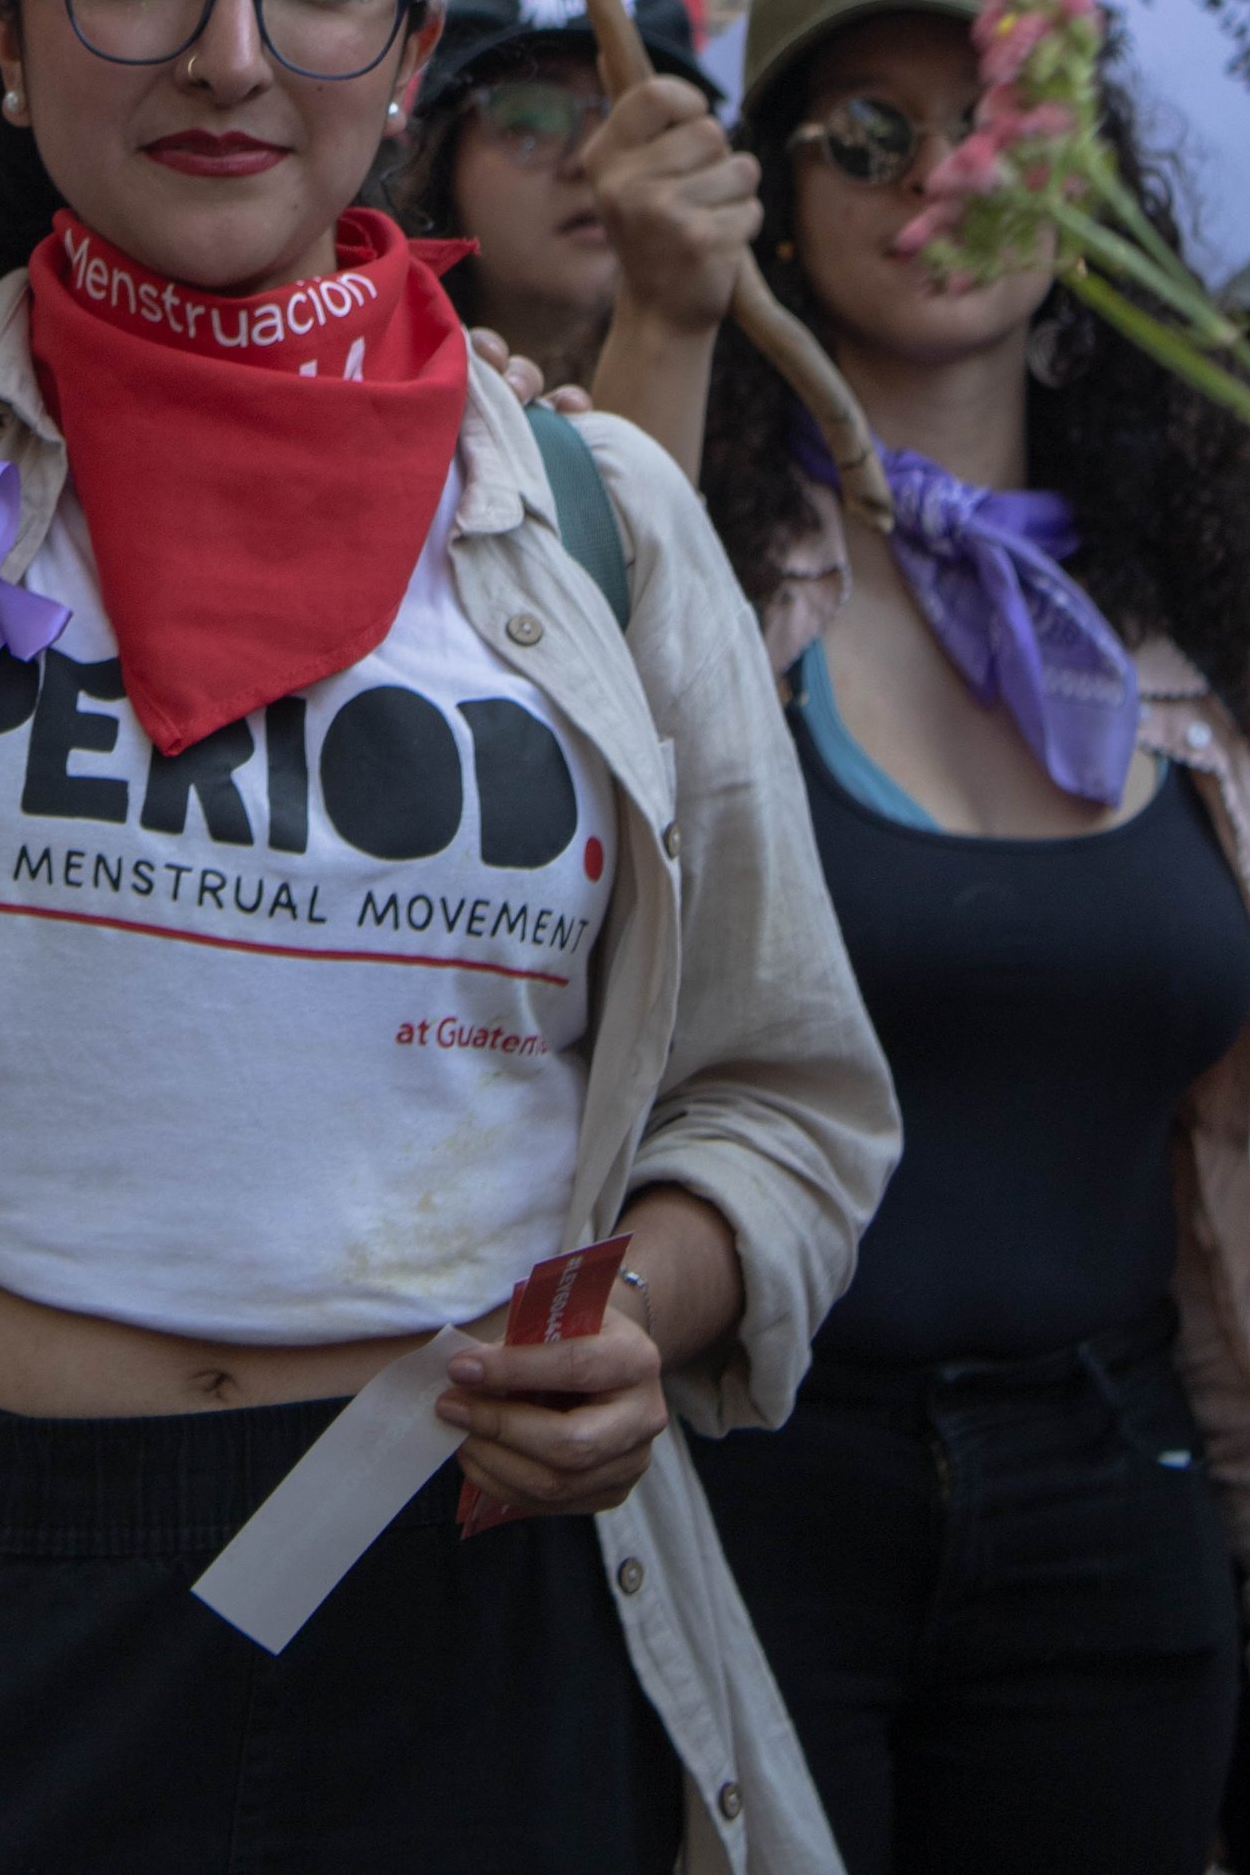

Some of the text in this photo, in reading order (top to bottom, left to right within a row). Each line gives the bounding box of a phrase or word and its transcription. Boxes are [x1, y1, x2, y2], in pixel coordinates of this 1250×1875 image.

[12, 844, 329, 926] MENSTRUAL
[357, 890, 590, 955] MOVEMENT
[395, 1020, 431, 1046] at
